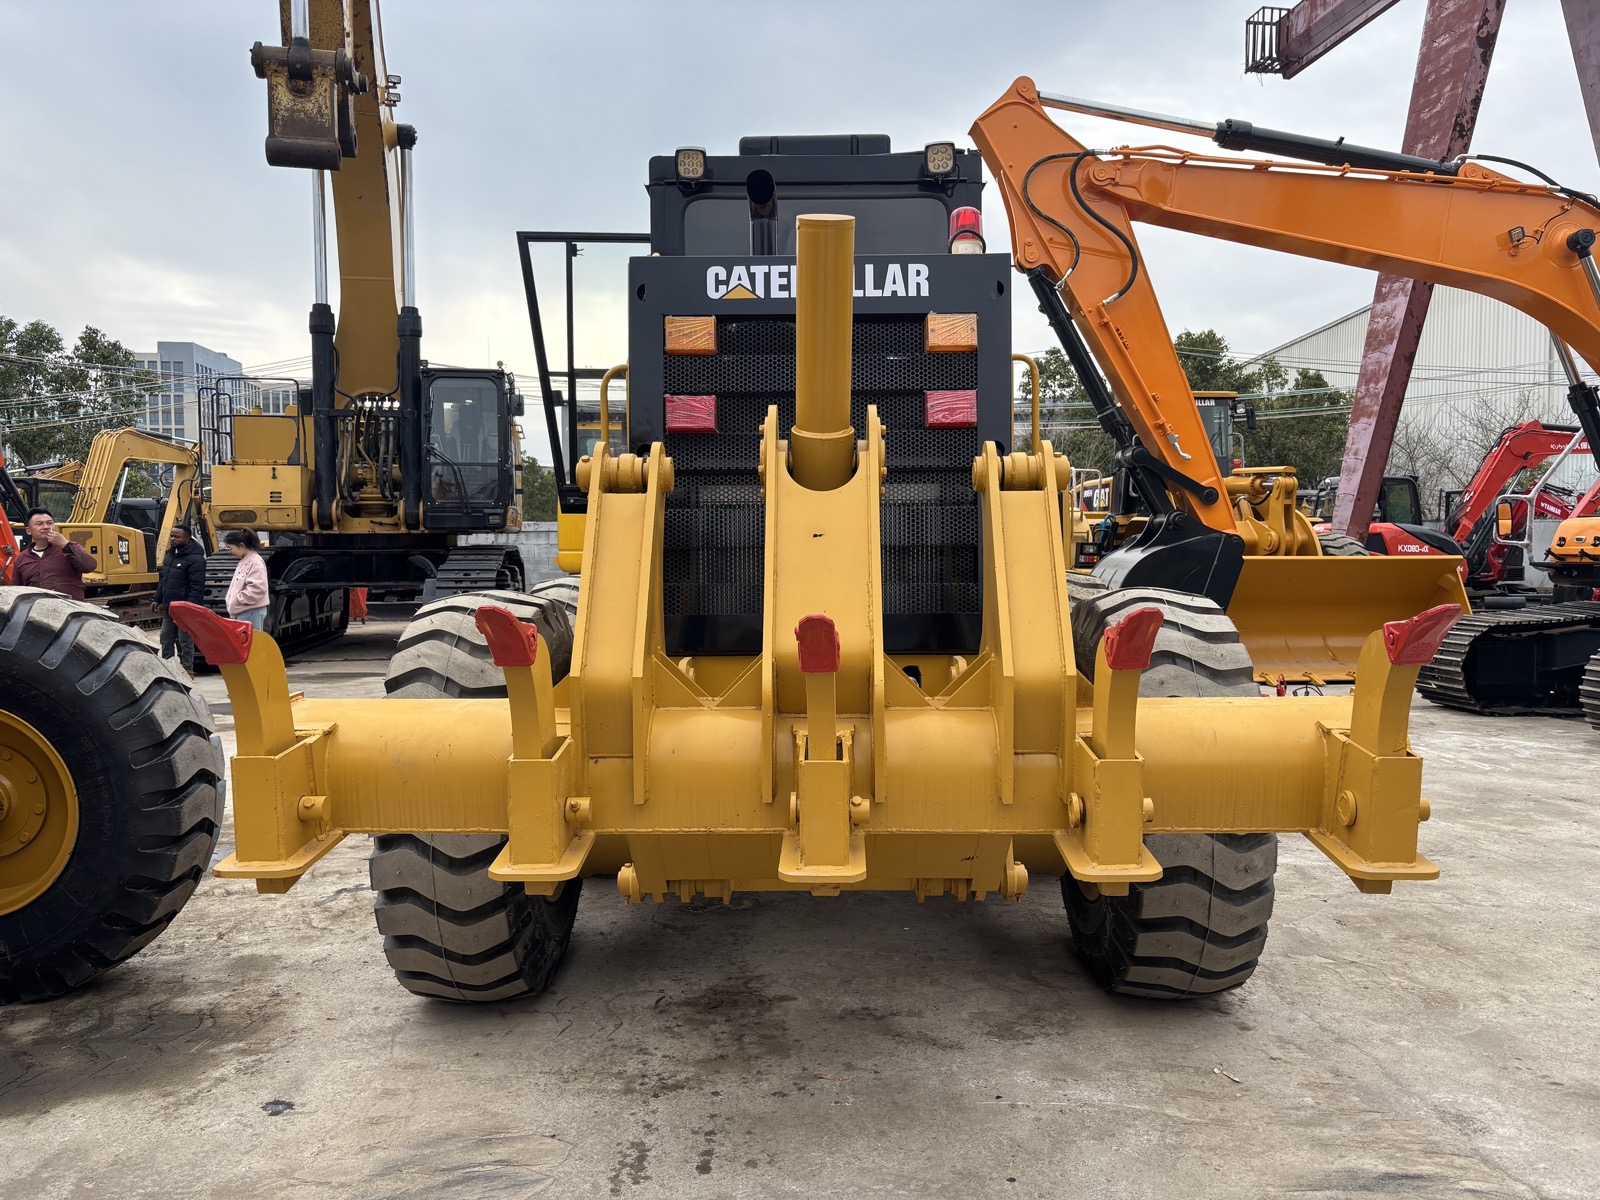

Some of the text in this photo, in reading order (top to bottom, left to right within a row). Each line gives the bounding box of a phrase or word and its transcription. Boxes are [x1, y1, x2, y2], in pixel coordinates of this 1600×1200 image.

[706, 263, 929, 299] CATELLAR
[1093, 487, 1110, 508] CAT
[1543, 502, 1562, 516] YANMAR
[118, 541, 129, 552] CAT
